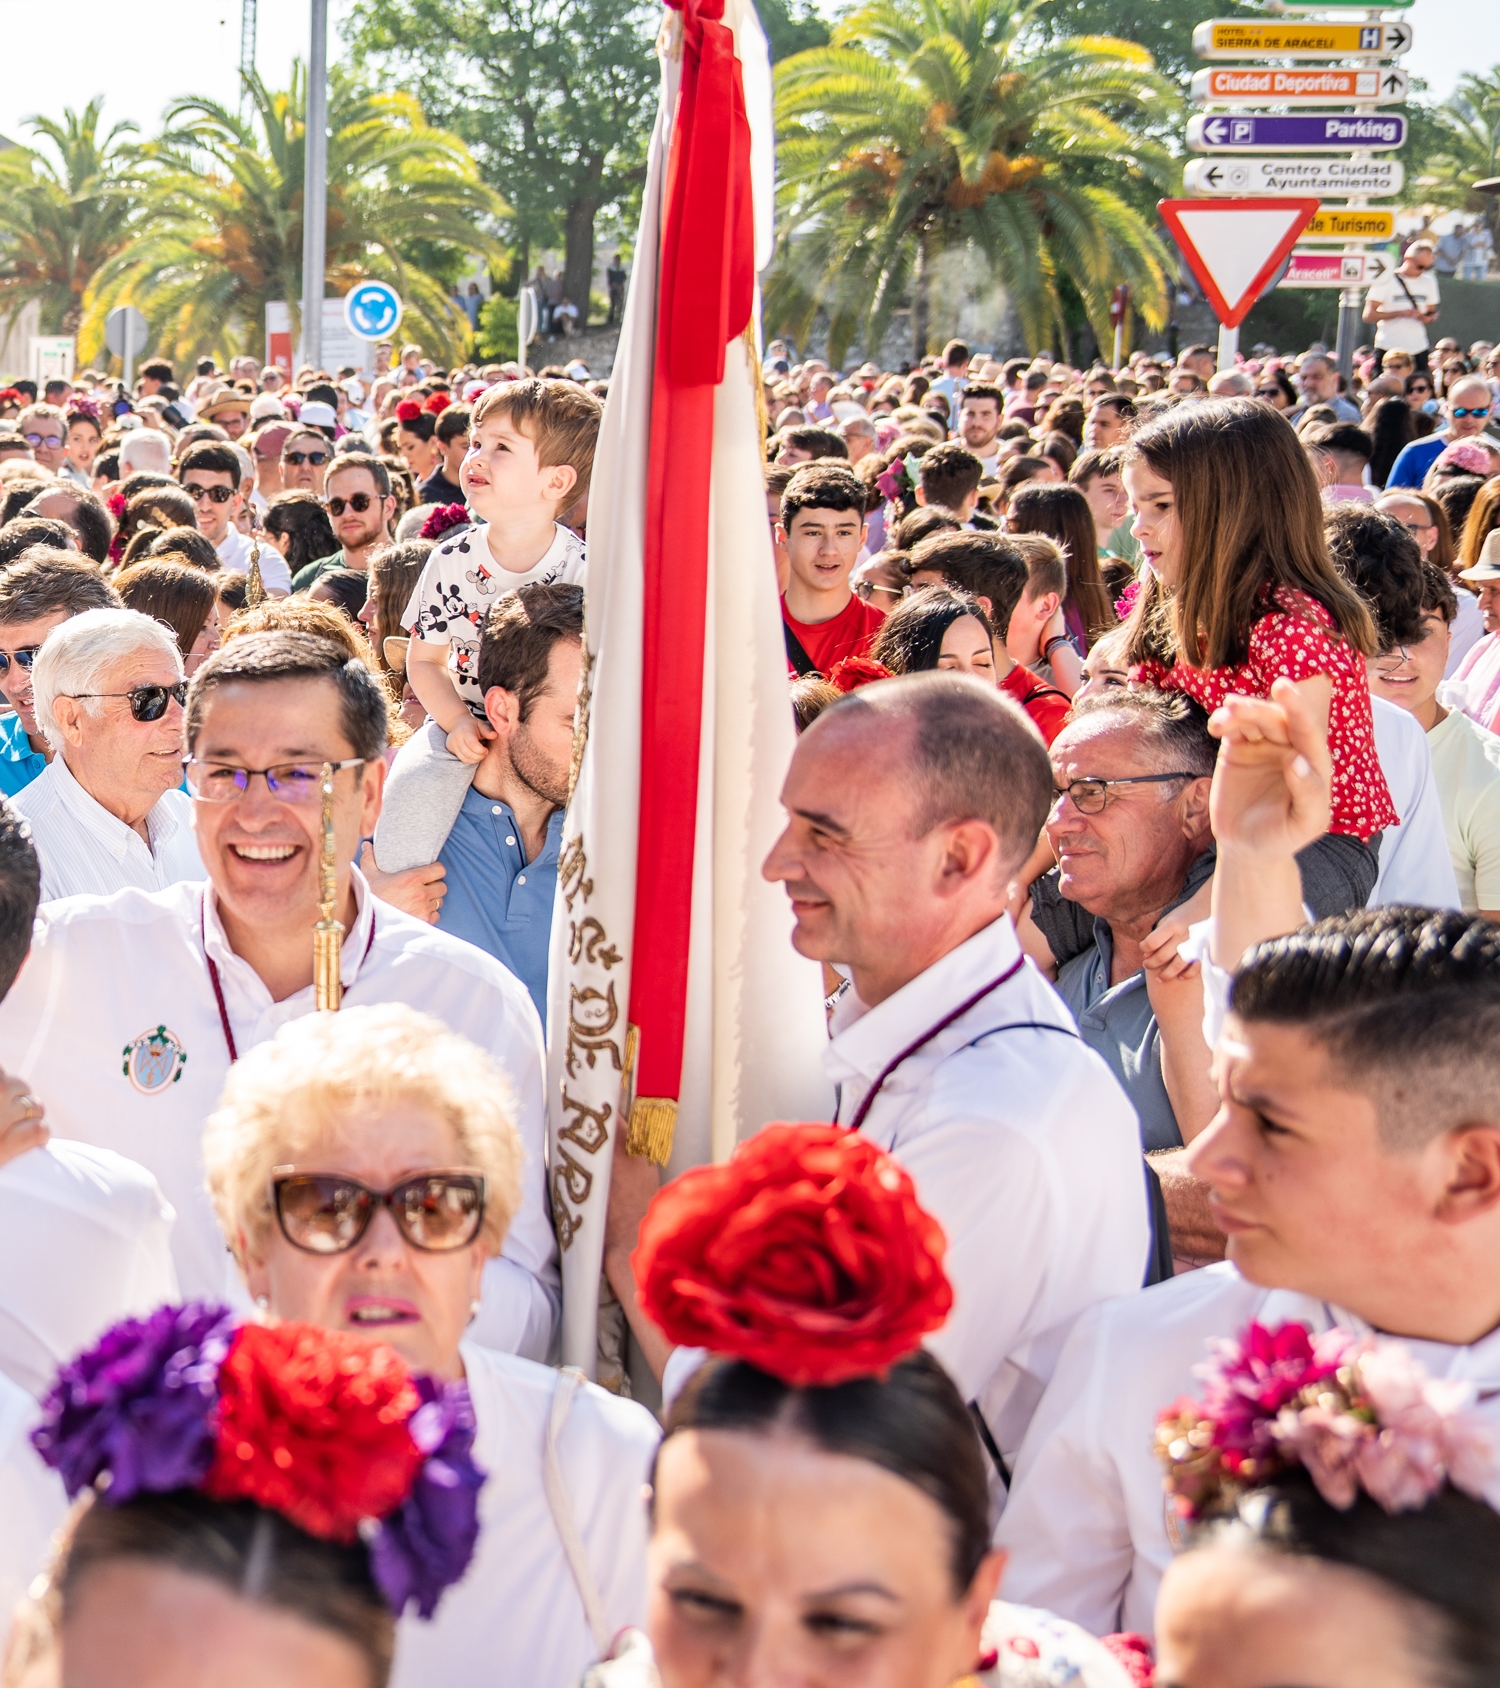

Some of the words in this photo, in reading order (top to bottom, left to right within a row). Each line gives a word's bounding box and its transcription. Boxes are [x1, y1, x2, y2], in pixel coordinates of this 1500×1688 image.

[1217, 28, 1246, 36] HOTEL
[1361, 28, 1380, 48] H
[1215, 38, 1260, 48] SIERRA
[1264, 38, 1280, 48] DE
[1283, 39, 1335, 49] ARACELI
[1215, 72, 1271, 92] Ciudad
[1273, 73, 1349, 94] Deportiva
[1234, 122, 1250, 141] P
[1325, 119, 1398, 141] Parking
[1261, 163, 1322, 175] Centro
[1328, 162, 1393, 175] Ciudad
[1265, 177, 1391, 190] Ayuntamiento
[1306, 217, 1324, 231] de
[1330, 217, 1386, 232] Turismo
